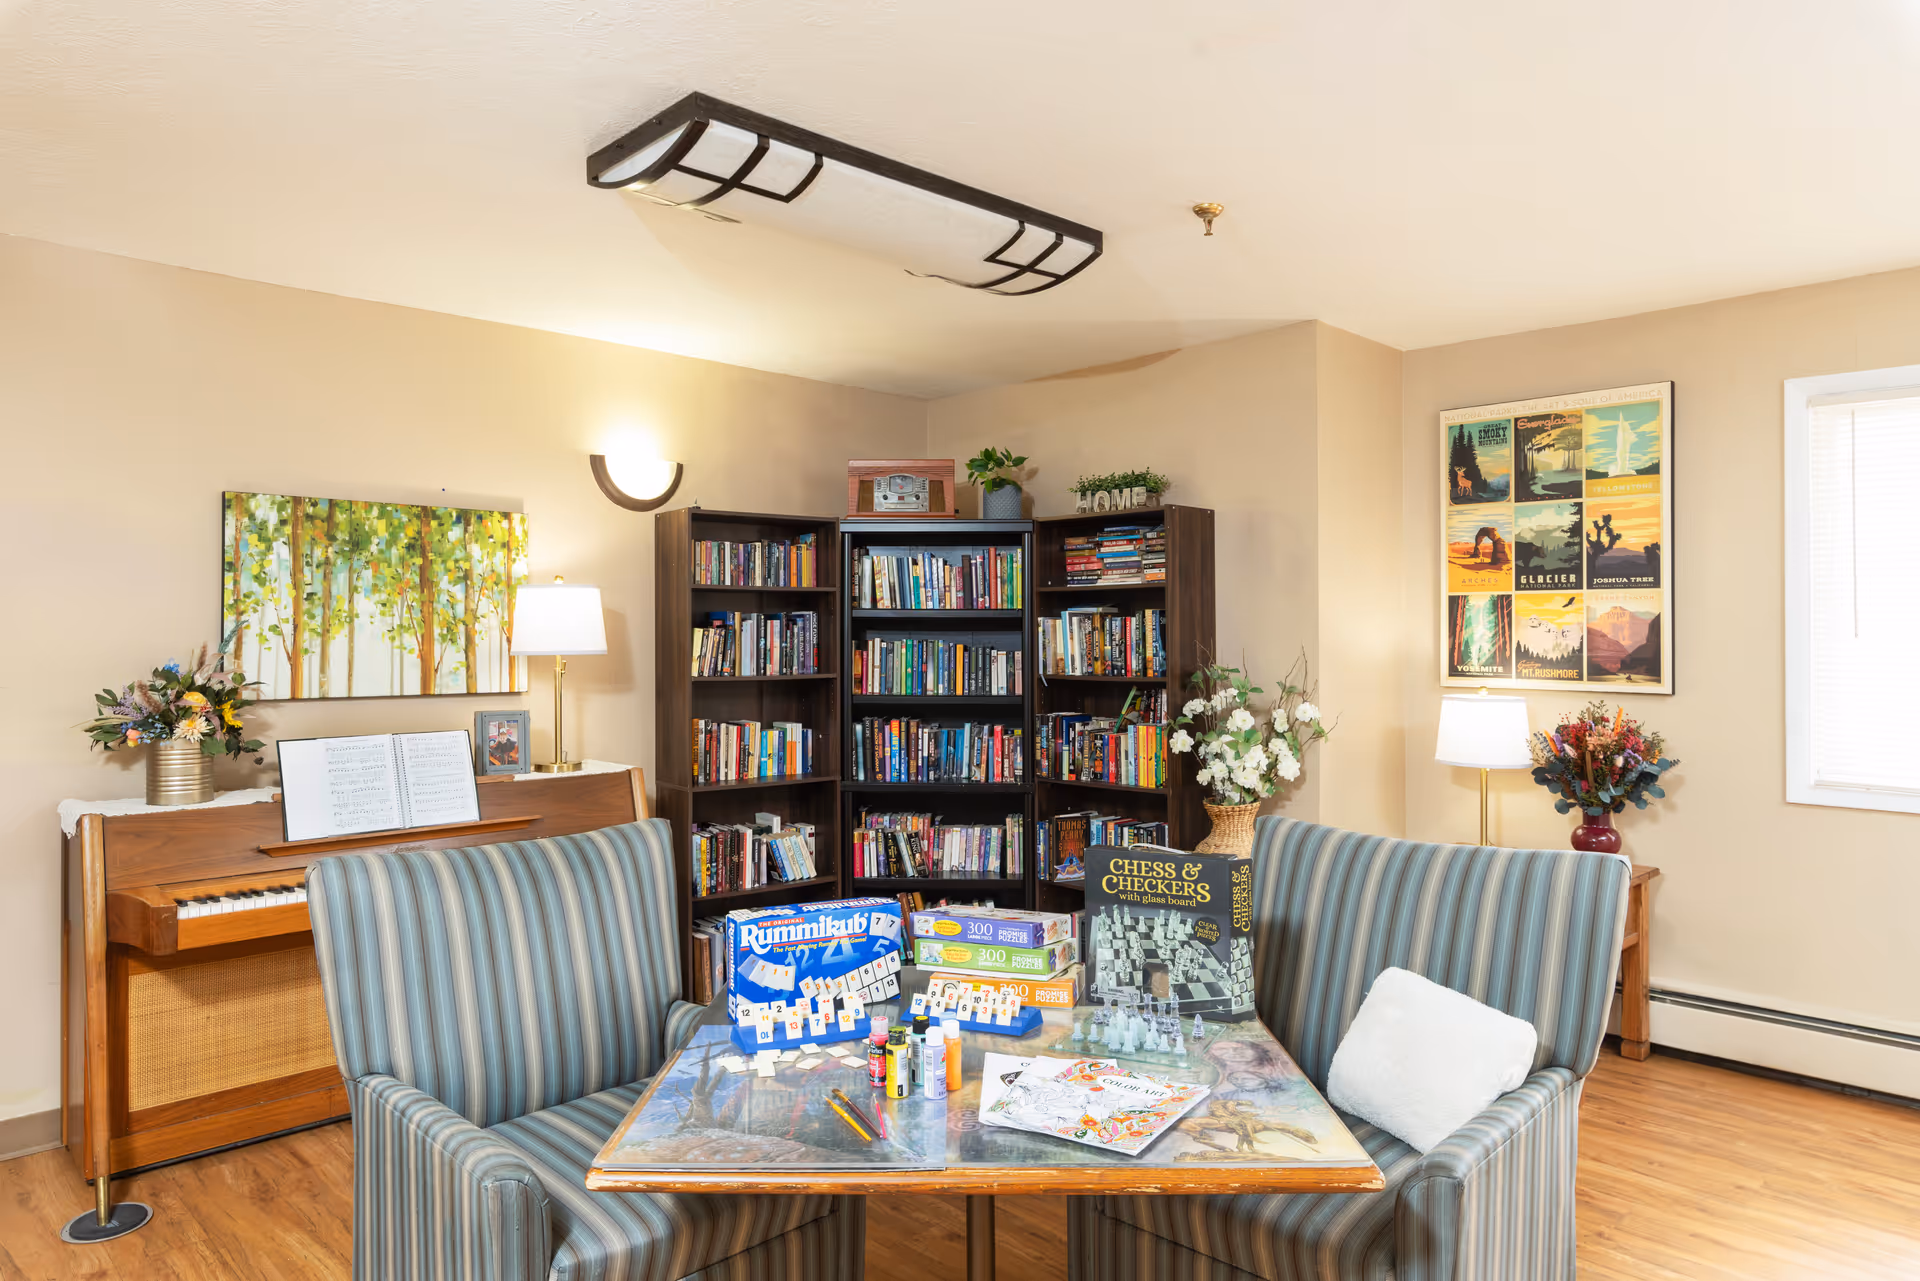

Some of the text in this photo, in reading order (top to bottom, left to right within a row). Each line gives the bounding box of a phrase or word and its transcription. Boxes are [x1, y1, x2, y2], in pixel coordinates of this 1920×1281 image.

[1478, 427, 1507, 440] SMOKY
[1076, 487, 1147, 514] HOME
[1520, 573, 1577, 584] GLACIER
[1457, 665, 1504, 673] YOSEMITE
[1535, 669, 1579, 679] RUSHMORE
[1057, 820, 1087, 831] THOMAS
[1110, 858, 1202, 880] CHESS &
[1102, 874, 1211, 902] CHECKERS
[1119, 892, 1196, 907] with glass board
[1232, 870, 1241, 928] CHESS &
[1240, 864, 1251, 932] CHECKERS
[773, 917, 803, 926] ORIGINAL
[875, 917, 896, 928] 7 7
[967, 922, 993, 936] 300
[998, 930, 1028, 938] PROMISE
[998, 935, 1028, 944] PUZZLES
[785, 944, 796, 952] Fast
[978, 948, 1006, 963] 300
[1012, 956, 1043, 965] PROMISE
[1012, 962, 1043, 970] PUZZLES
[804, 982, 811, 990] 2
[886, 978, 895, 986] 13
[948, 993, 953, 1001] 6
[973, 995, 981, 1004] 10
[1036, 990, 1068, 998] PROMISE
[1036, 995, 1068, 1003] PUZZLES
[741, 1008, 750, 1016] 12
[776, 1005, 782, 1013] 2
[915, 998, 1007, 1016] 12 4 6 3 4
[789, 1022, 798, 1030] 13
[815, 1018, 820, 1027] 7
[824, 1013, 830, 1021] 6
[854, 1008, 860, 1016] 9
[1102, 1077, 1167, 1098] COLOR ART
